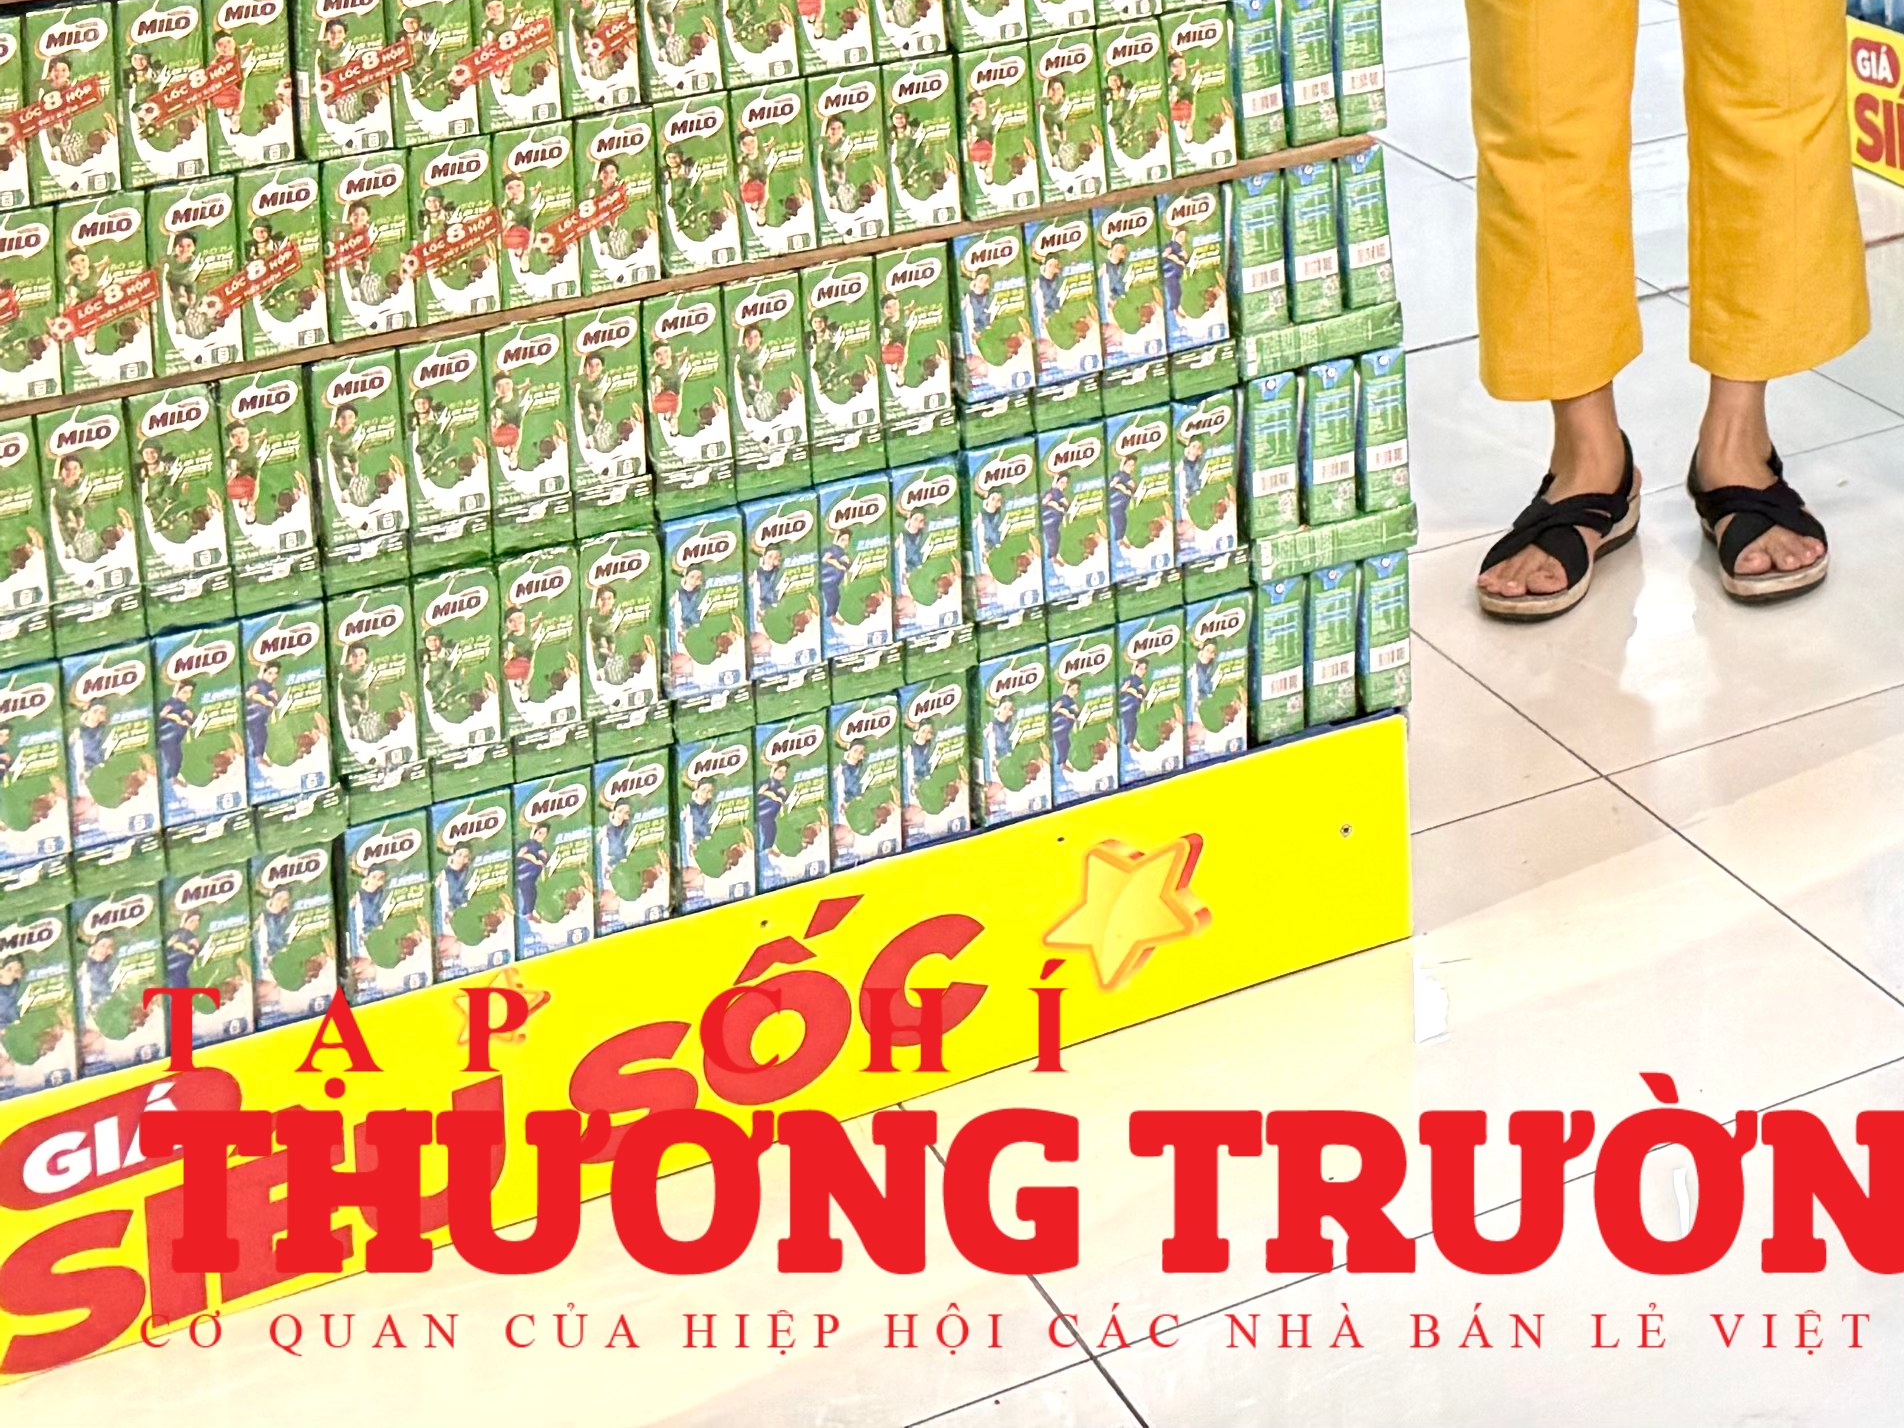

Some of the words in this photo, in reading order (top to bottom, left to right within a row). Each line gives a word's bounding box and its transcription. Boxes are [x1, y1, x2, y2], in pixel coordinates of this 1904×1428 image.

[1856, 45, 1894, 83] GIÁ
[41, 89, 63, 111] 8
[432, 160, 480, 177] MILO
[1170, 197, 1209, 221] MILO
[421, 360, 469, 380] MILO
[1133, 631, 1174, 653] MILO
